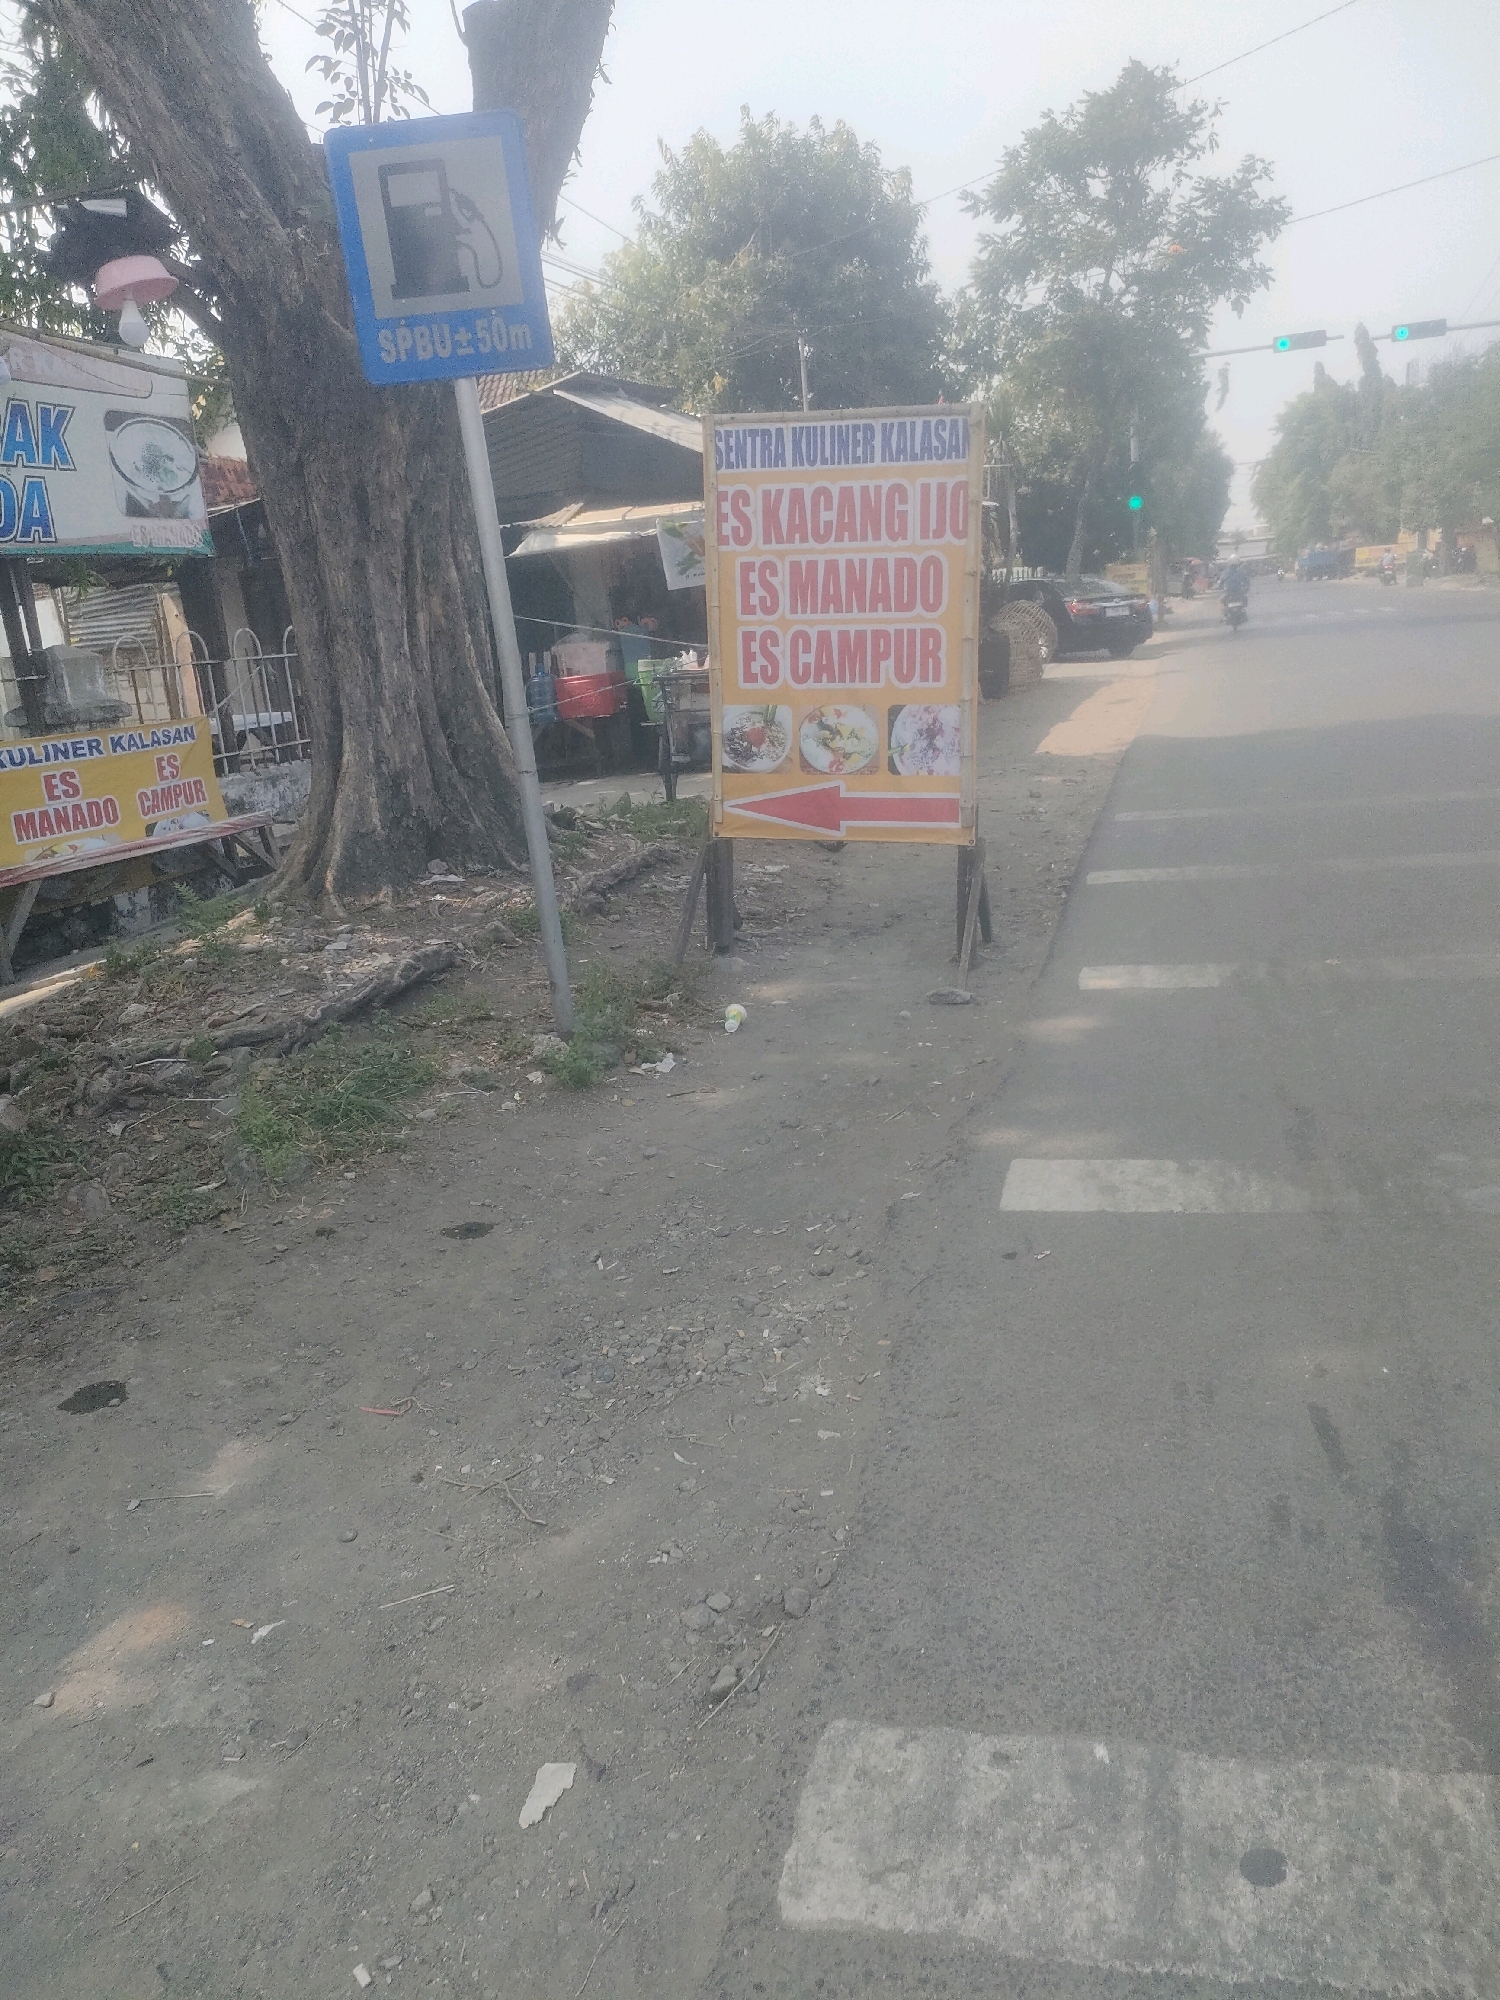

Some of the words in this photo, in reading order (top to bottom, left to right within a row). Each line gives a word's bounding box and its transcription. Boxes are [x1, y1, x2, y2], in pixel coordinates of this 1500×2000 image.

[0, 397, 76, 471] AK
[715, 427, 787, 471] SENTRA
[791, 423, 876, 468] KULINER
[717, 488, 753, 547] ES
[761, 482, 909, 545] KACANG
[919, 480, 969, 541] IJO
[739, 559, 780, 617] ES
[789, 554, 944, 615] MANADO
[741, 629, 780, 685] ES
[789, 627, 943, 685] CAMPUR
[109, 725, 196, 754] KALASAN
[42, 771, 81, 802] ES
[155, 754, 180, 782] ES
[13, 797, 120, 842] MANADO
[137, 778, 208, 817] CAMPUR
